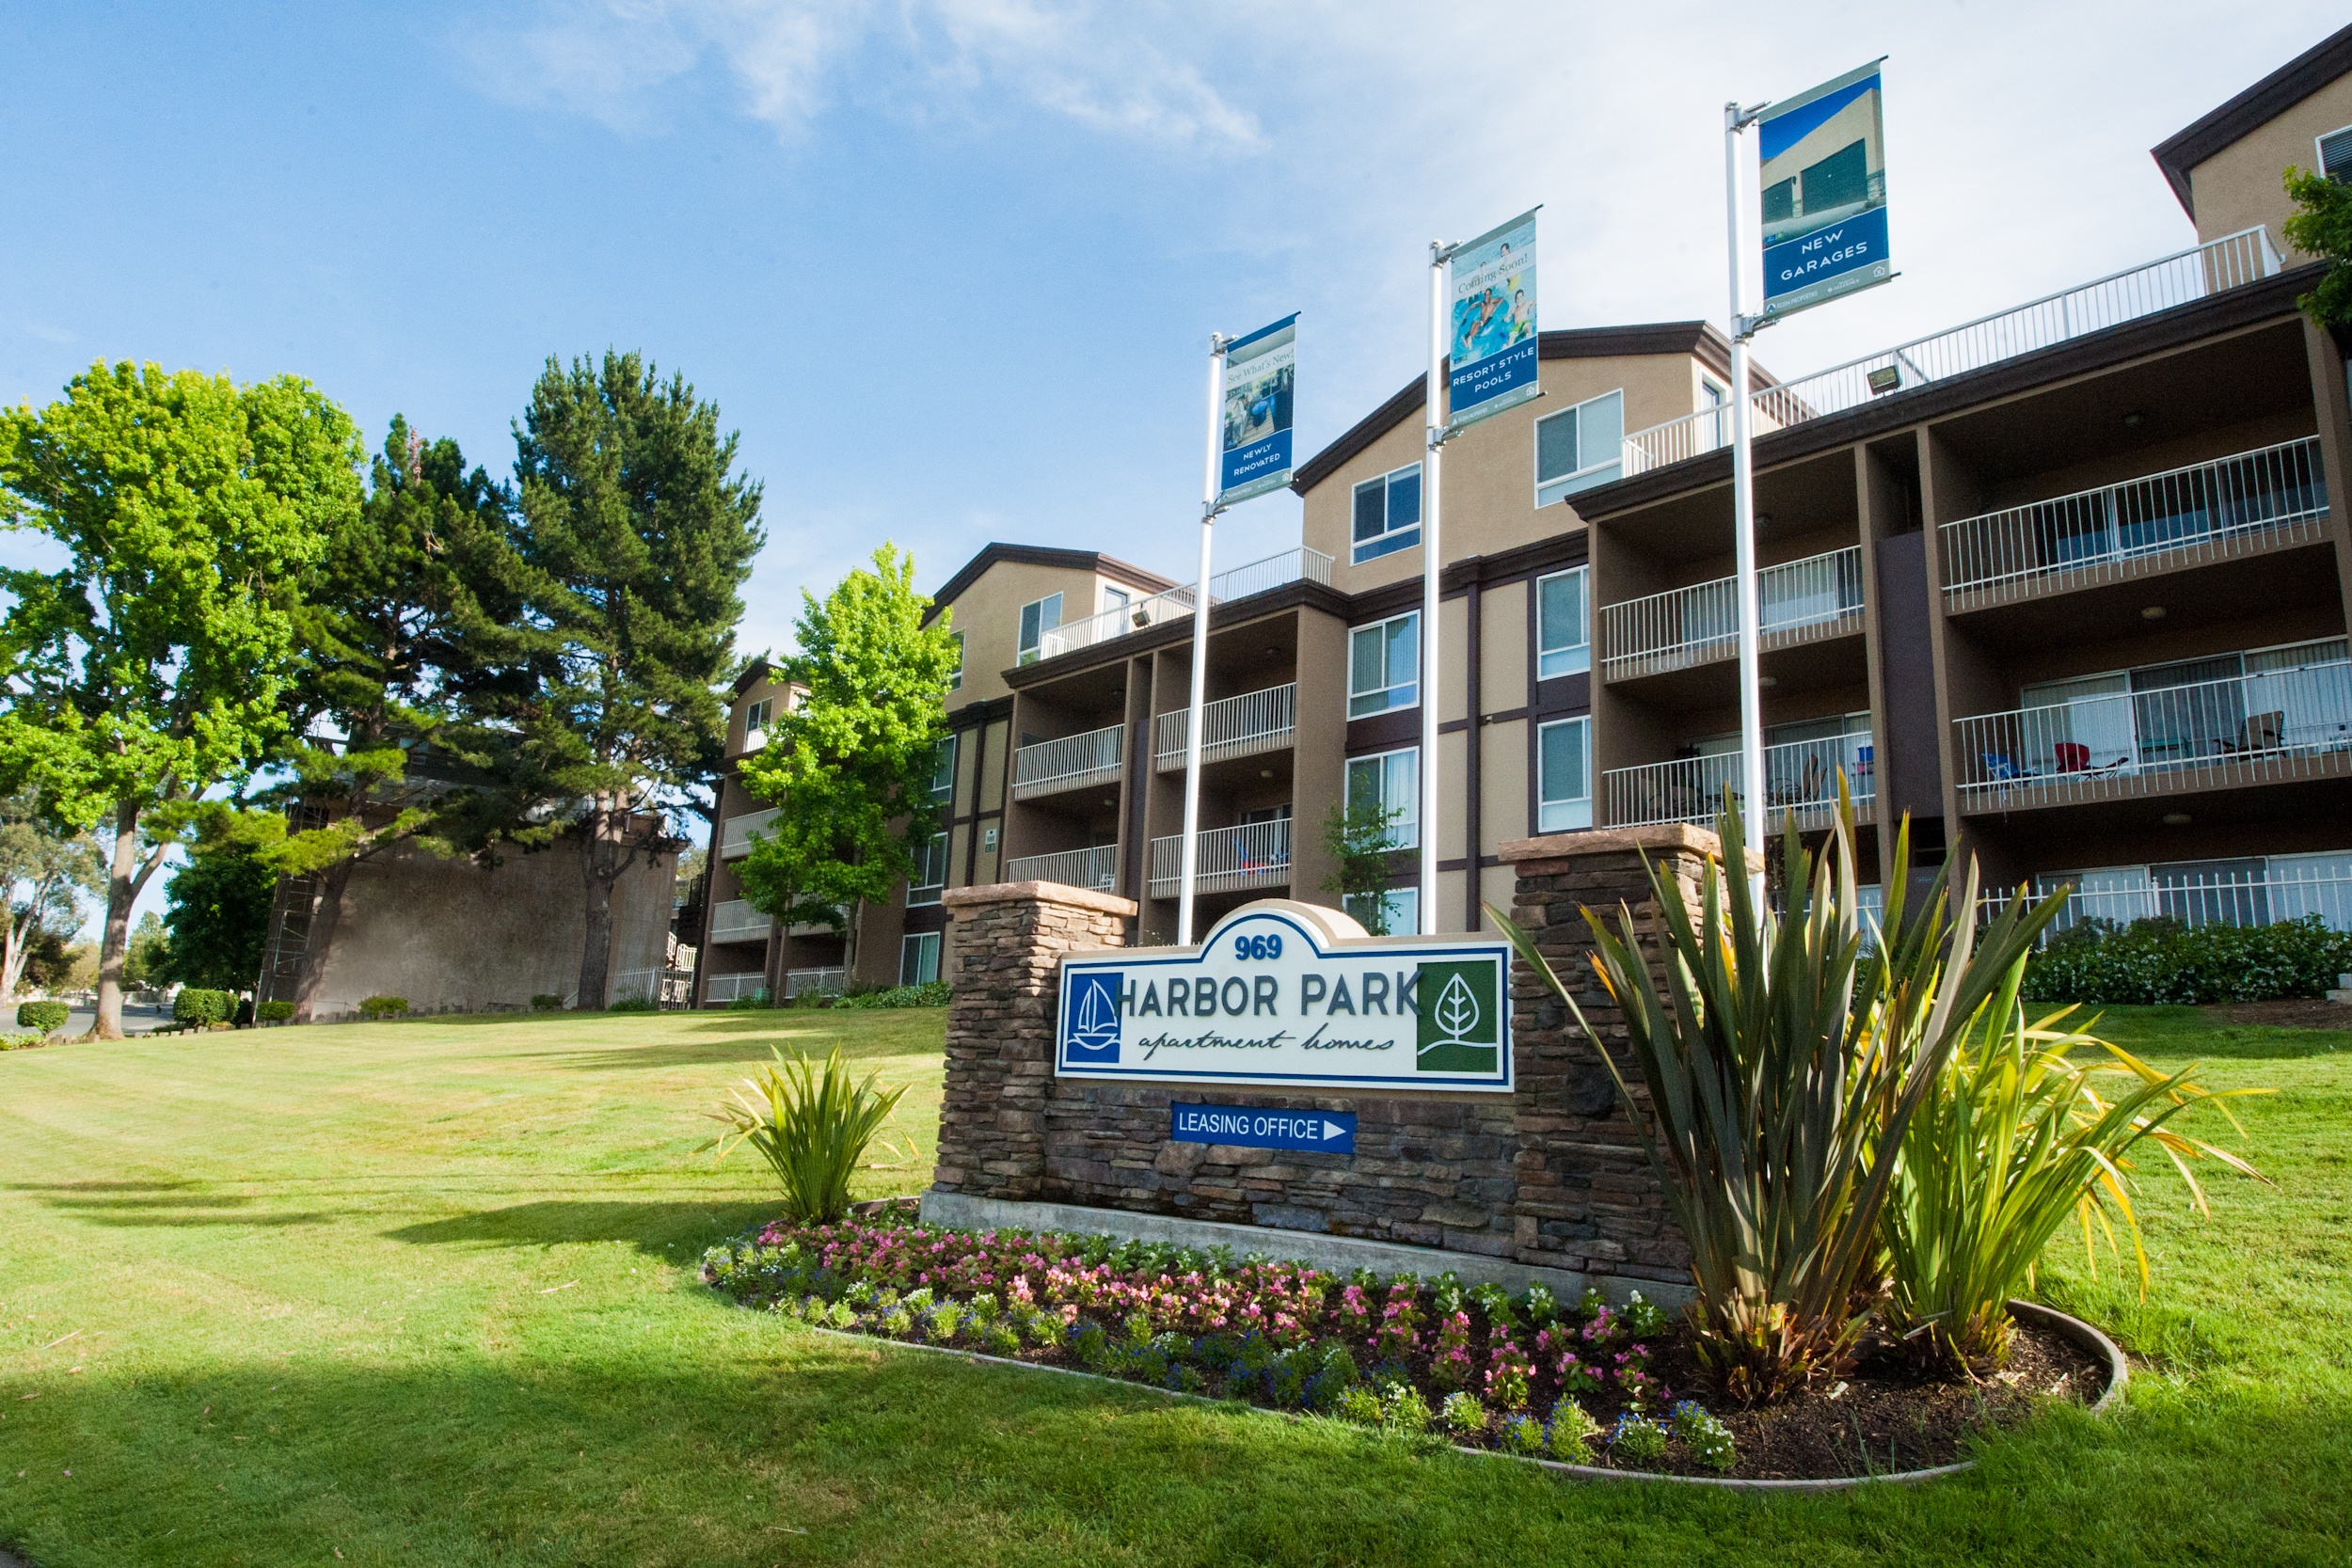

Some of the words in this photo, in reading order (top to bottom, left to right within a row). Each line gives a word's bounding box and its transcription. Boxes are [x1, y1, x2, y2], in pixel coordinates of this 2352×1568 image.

[1802, 229, 1843, 255] NEW
[1458, 272, 1497, 293] Coming
[1499, 253, 1528, 275] Soon!
[1781, 241, 1867, 280] GARAGES
[1227, 373, 1242, 385] See
[1243, 359, 1271, 377] What's
[1273, 348, 1295, 365] New!
[1453, 363, 1496, 387] RESORT
[1499, 346, 1534, 369] STYLE
[1474, 371, 1512, 393] POOLS
[1233, 452, 1280, 477] RENOVATED
[1243, 443, 1272, 461] NEWLY
[1234, 934, 1282, 960] 969
[1115, 974, 1279, 1018] HARBOR
[1300, 970, 1423, 1017] PARK
[1138, 1030, 1296, 1061] apartment
[1300, 1022, 1394, 1050] homes
[1179, 1112, 1249, 1135] LEASING
[1254, 1117, 1318, 1140] OFFICE
